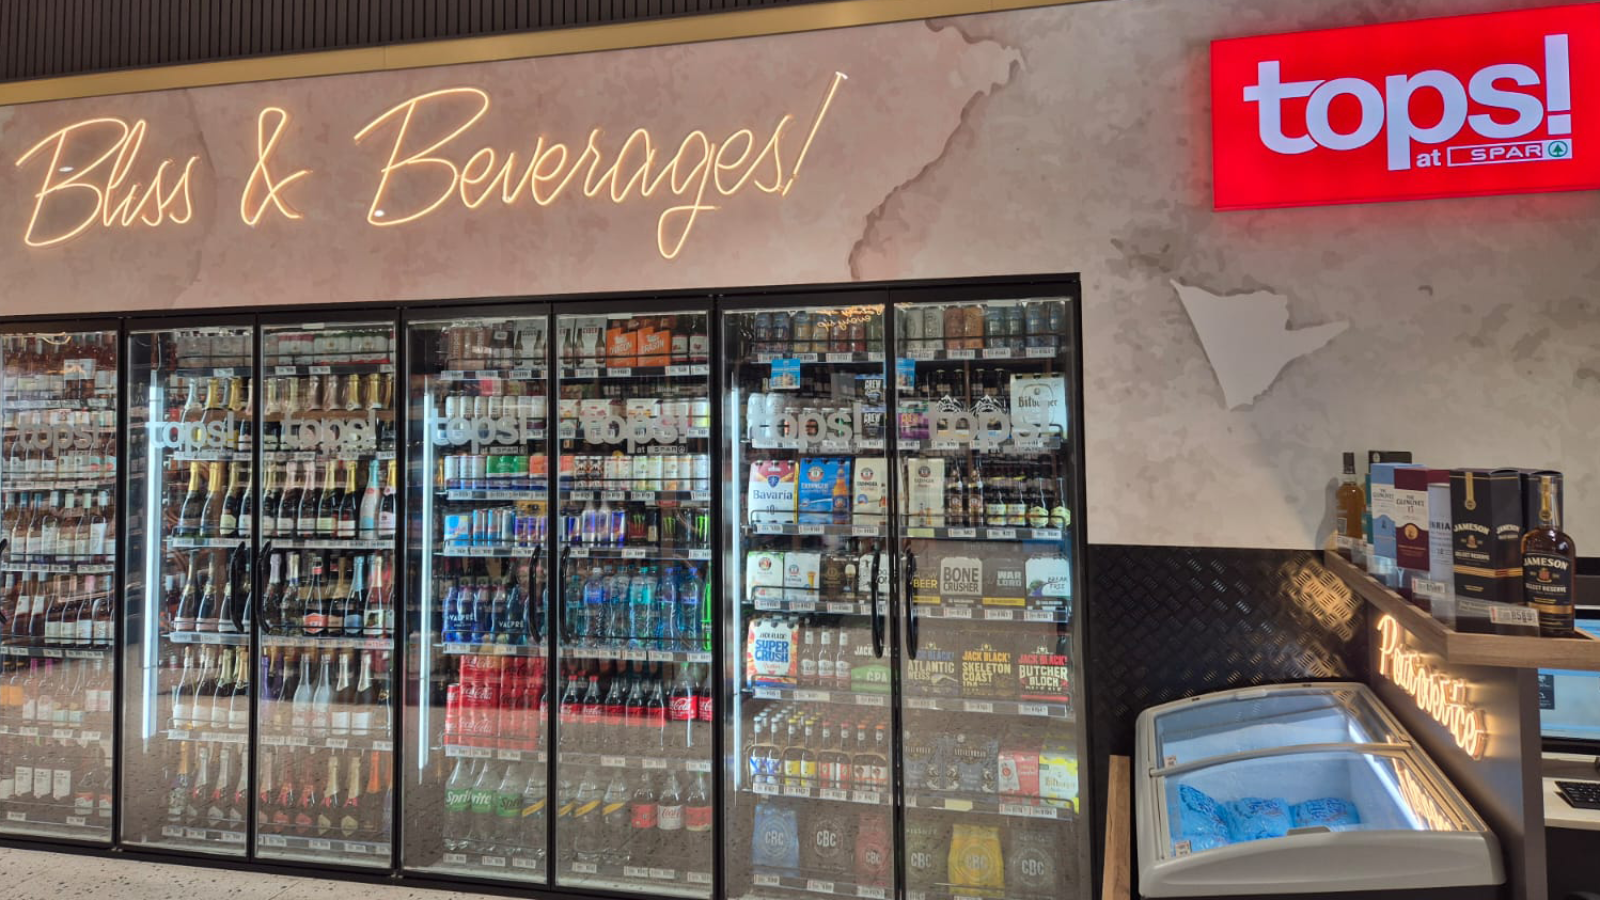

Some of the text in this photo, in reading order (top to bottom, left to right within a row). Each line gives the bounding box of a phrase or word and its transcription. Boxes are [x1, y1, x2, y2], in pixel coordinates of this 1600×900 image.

[1243, 33, 1572, 171] tops!
[1416, 143, 1542, 168] at SPAR
[14, 70, 848, 260] Bliss & Beverages!
[427, 399, 527, 454] tops!
[579, 402, 687, 454] tops!
[747, 401, 862, 454] tops!
[18, 411, 100, 457] tops!
[145, 411, 235, 457] tops!
[753, 489, 793, 500] Bavaria
[1453, 523, 1490, 536] JAMESON
[1523, 556, 1569, 571] JAMESON
[943, 567, 980, 582] BONE
[997, 570, 1022, 579] WAR
[913, 579, 938, 589] BEER
[943, 582, 979, 593] CRUSHER
[755, 639, 789, 651] SUPER
[854, 646, 873, 657] JACK
[755, 649, 789, 663] CRUSH
[962, 651, 983, 662] JACK
[1018, 654, 1038, 665] JACK
[907, 660, 955, 674] ATLANTIC
[962, 662, 1012, 675] SKELETON
[1019, 665, 1068, 681] BUTCHER
[866, 671, 888, 683] CPA
[907, 671, 930, 681] WEISS
[962, 672, 994, 683] COAST
[1029, 676, 1059, 688] BLOCK
[765, 830, 784, 846] CBC
[816, 830, 837, 847] CBC
[866, 851, 881, 864] CBC
[911, 852, 932, 869] CBC
[1021, 859, 1045, 877] CBC
